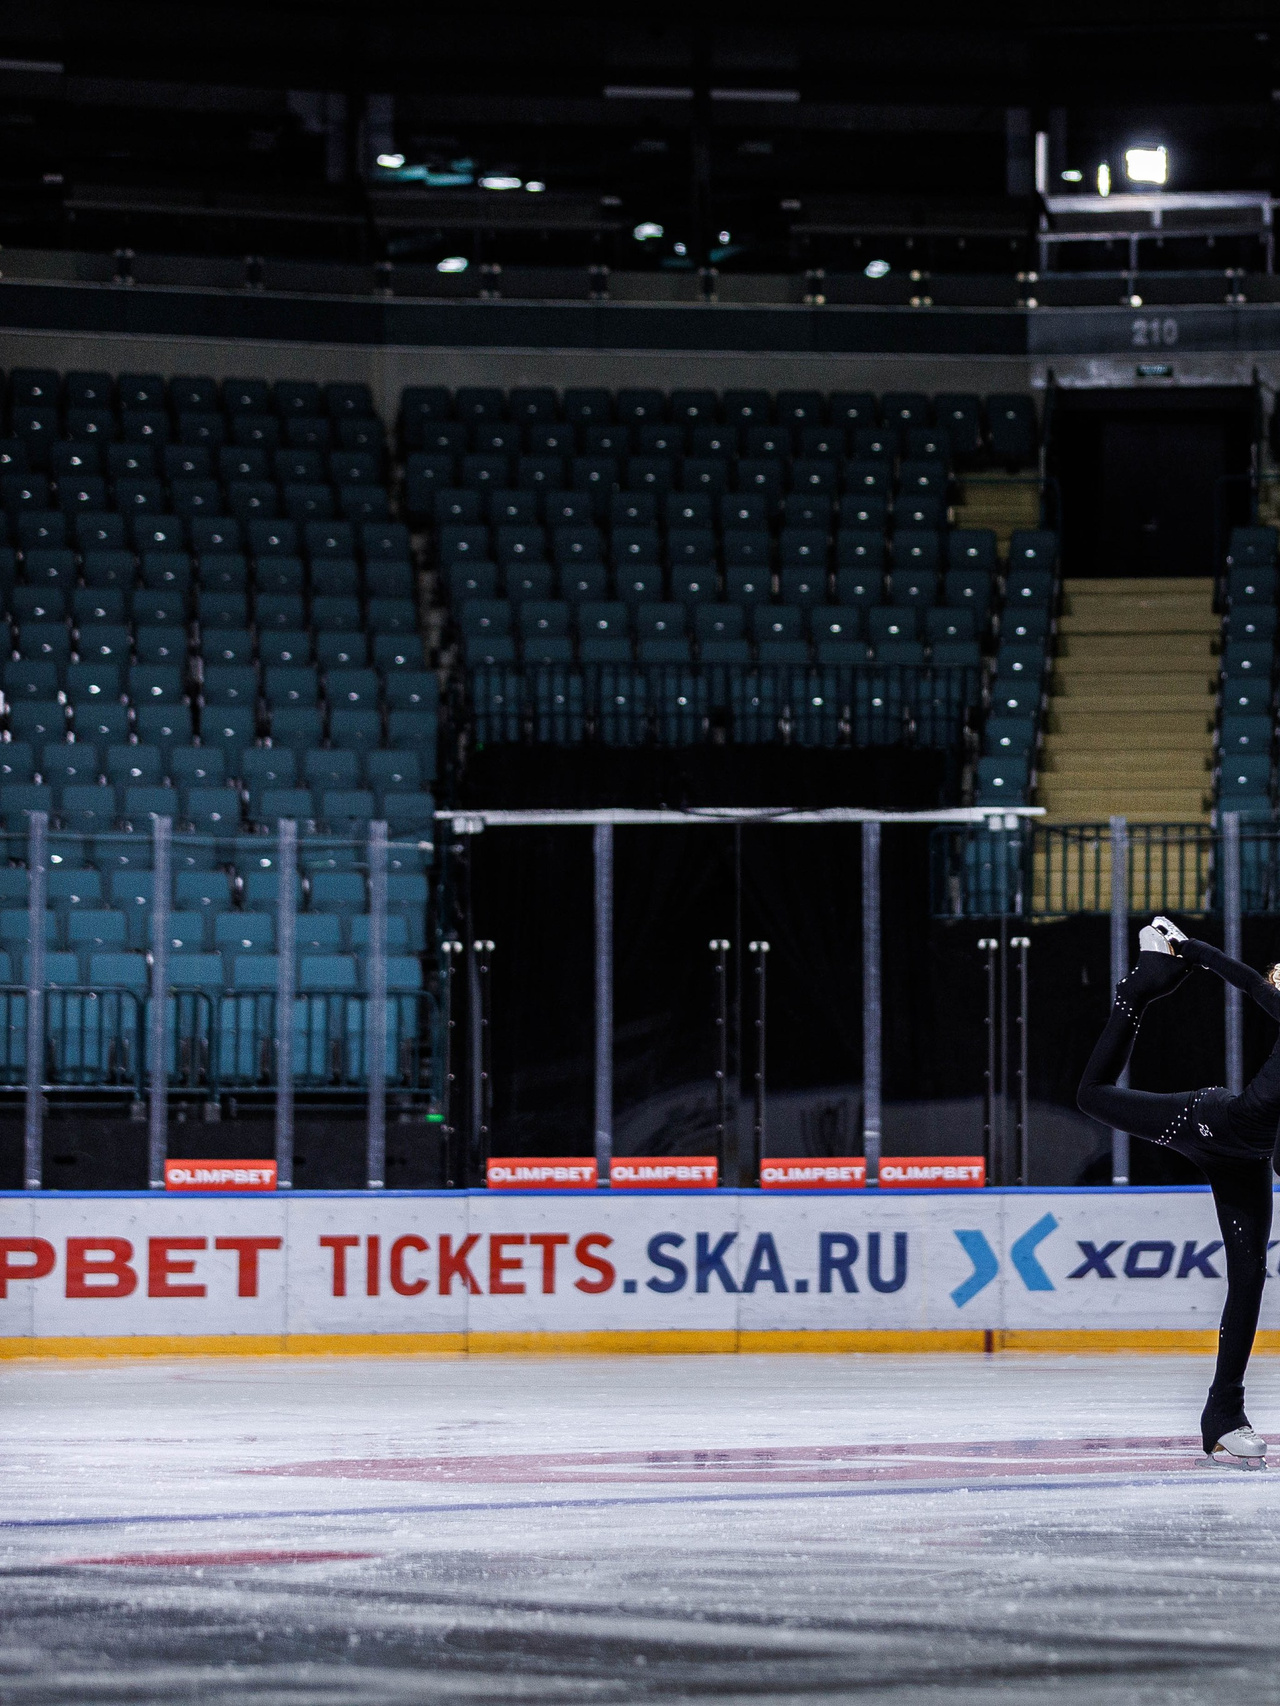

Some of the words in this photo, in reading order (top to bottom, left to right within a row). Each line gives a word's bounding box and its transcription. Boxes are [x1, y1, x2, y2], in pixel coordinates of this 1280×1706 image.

[1132, 318, 1178, 345] 210
[168, 1168, 275, 1185] OLIMPBET
[487, 1166, 594, 1182] OLIMPBET
[611, 1165, 717, 1181] OLIMPBET
[761, 1166, 866, 1182] OLIMPBET
[880, 1166, 982, 1181] OLIMPBET
[0, 1236, 283, 1298] PBET
[319, 1231, 907, 1297] TICKETS.SKA.RU
